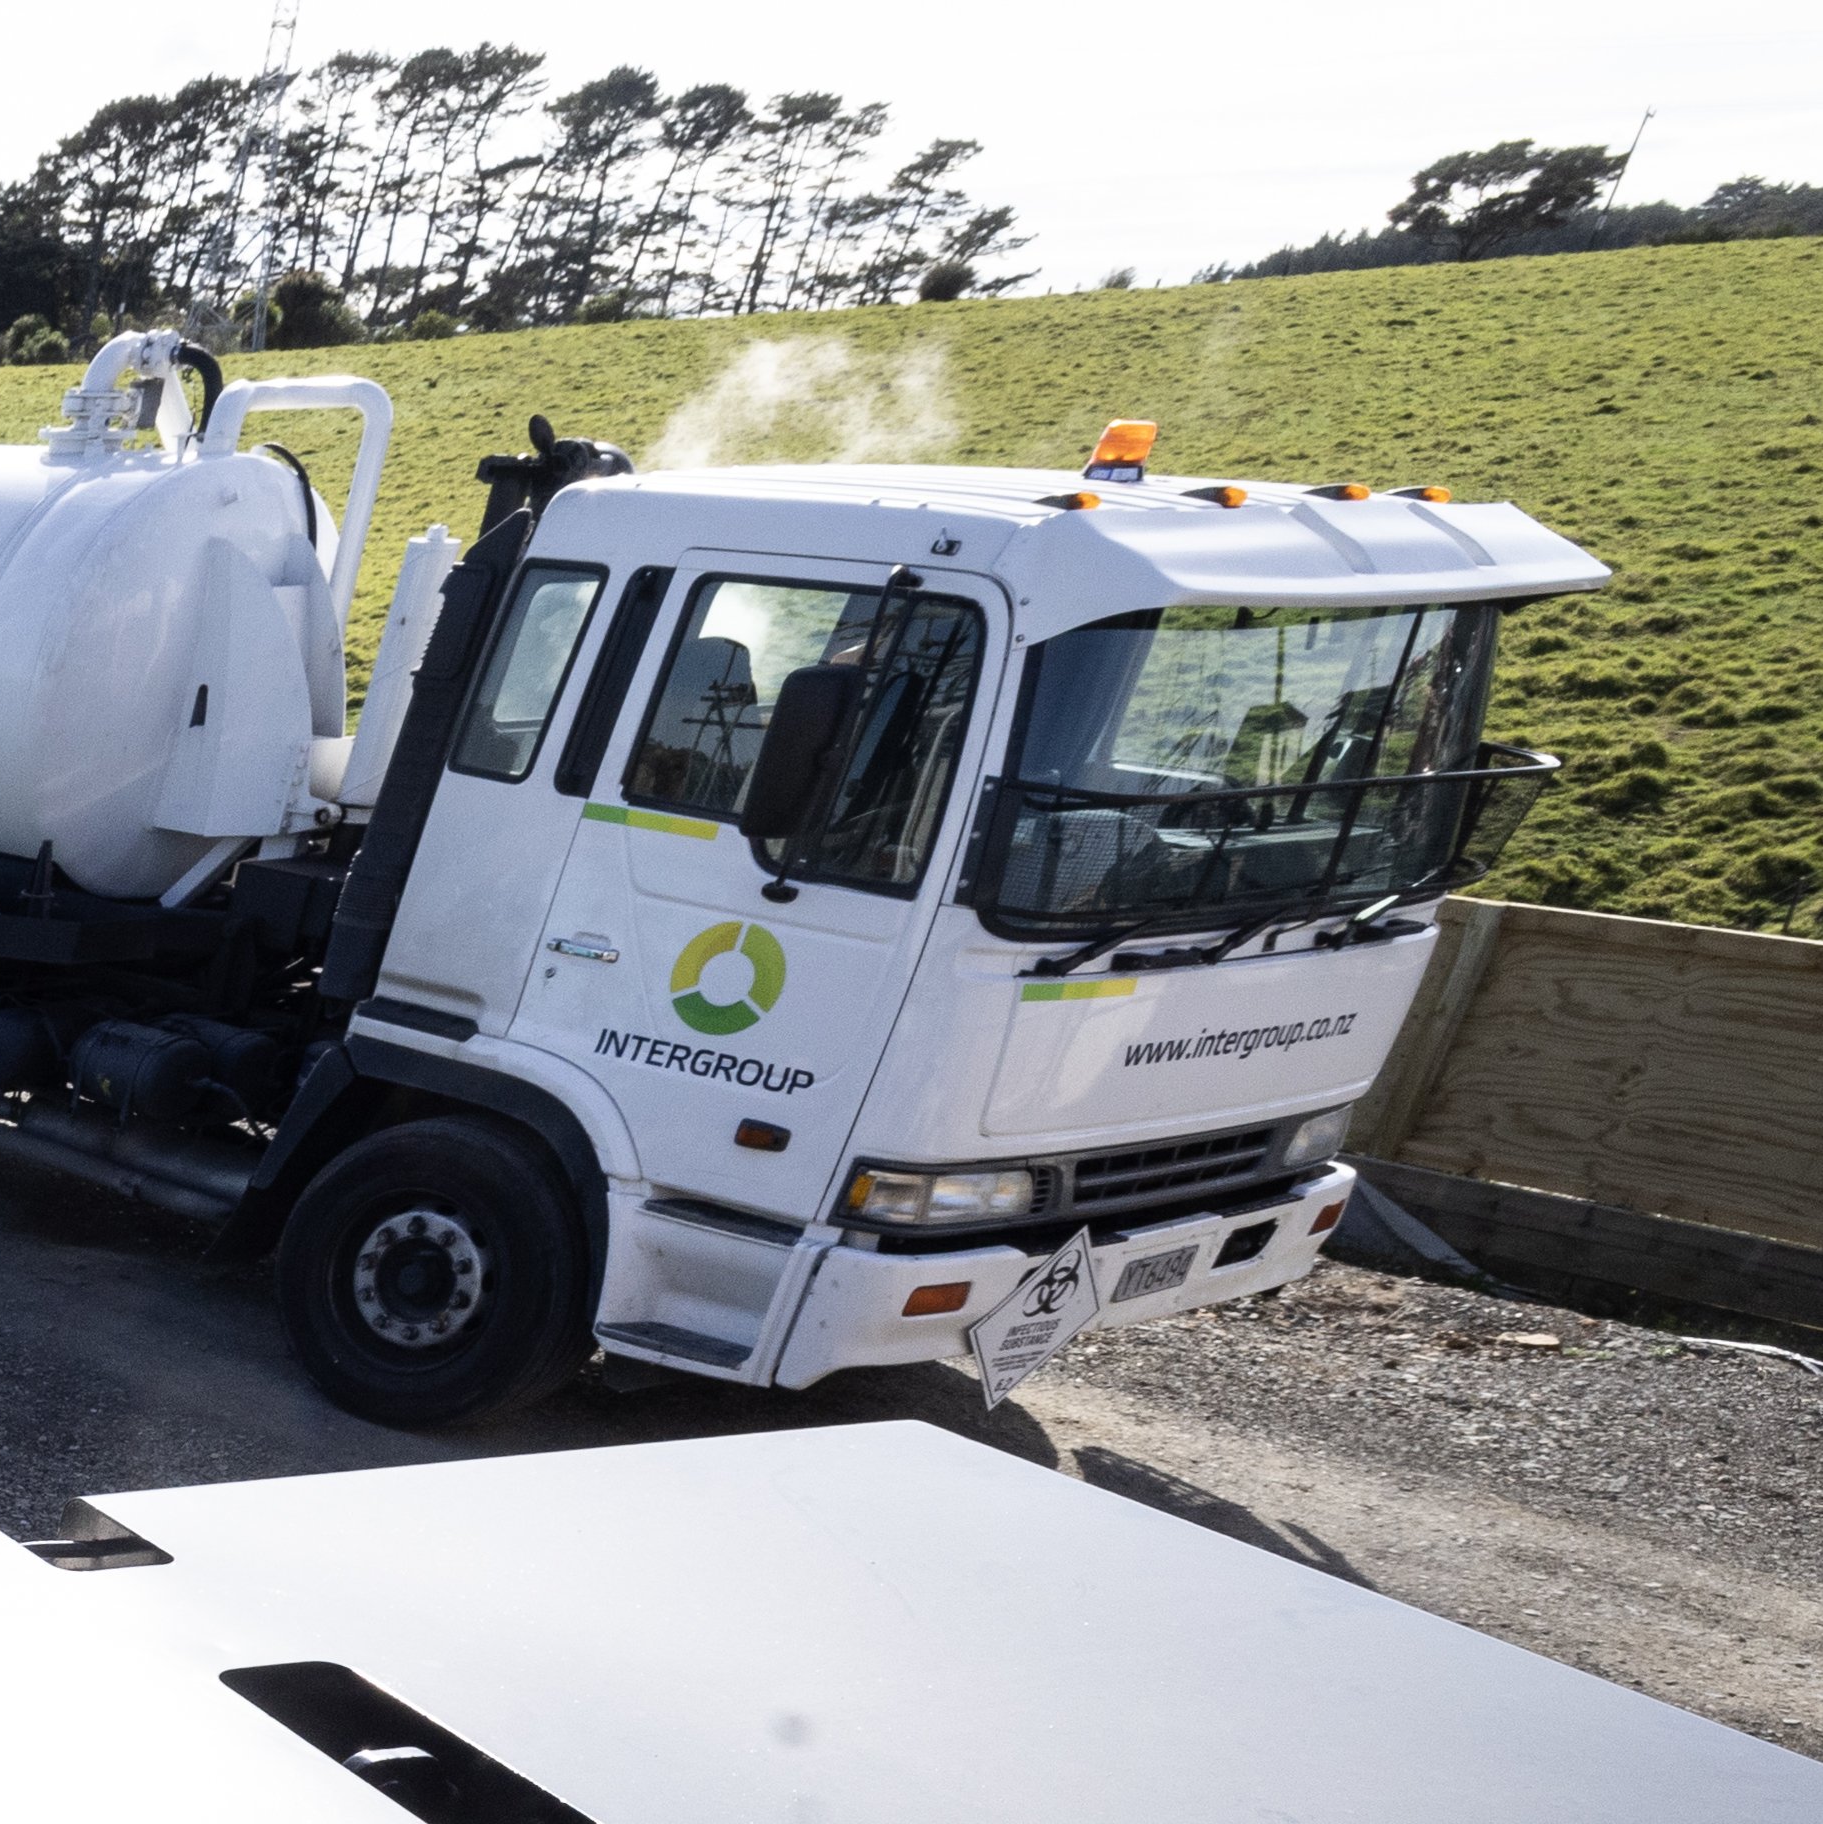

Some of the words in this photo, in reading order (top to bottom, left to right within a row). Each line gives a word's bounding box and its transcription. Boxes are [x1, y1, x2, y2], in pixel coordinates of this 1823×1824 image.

[1124, 1012, 1358, 1067] www.intergroup.co.nz
[594, 1028, 814, 1095] INTERGROUP
[999, 1332, 1054, 1351] SUBSTANCE
[1006, 1318, 1062, 1338] INFECTIOUS
